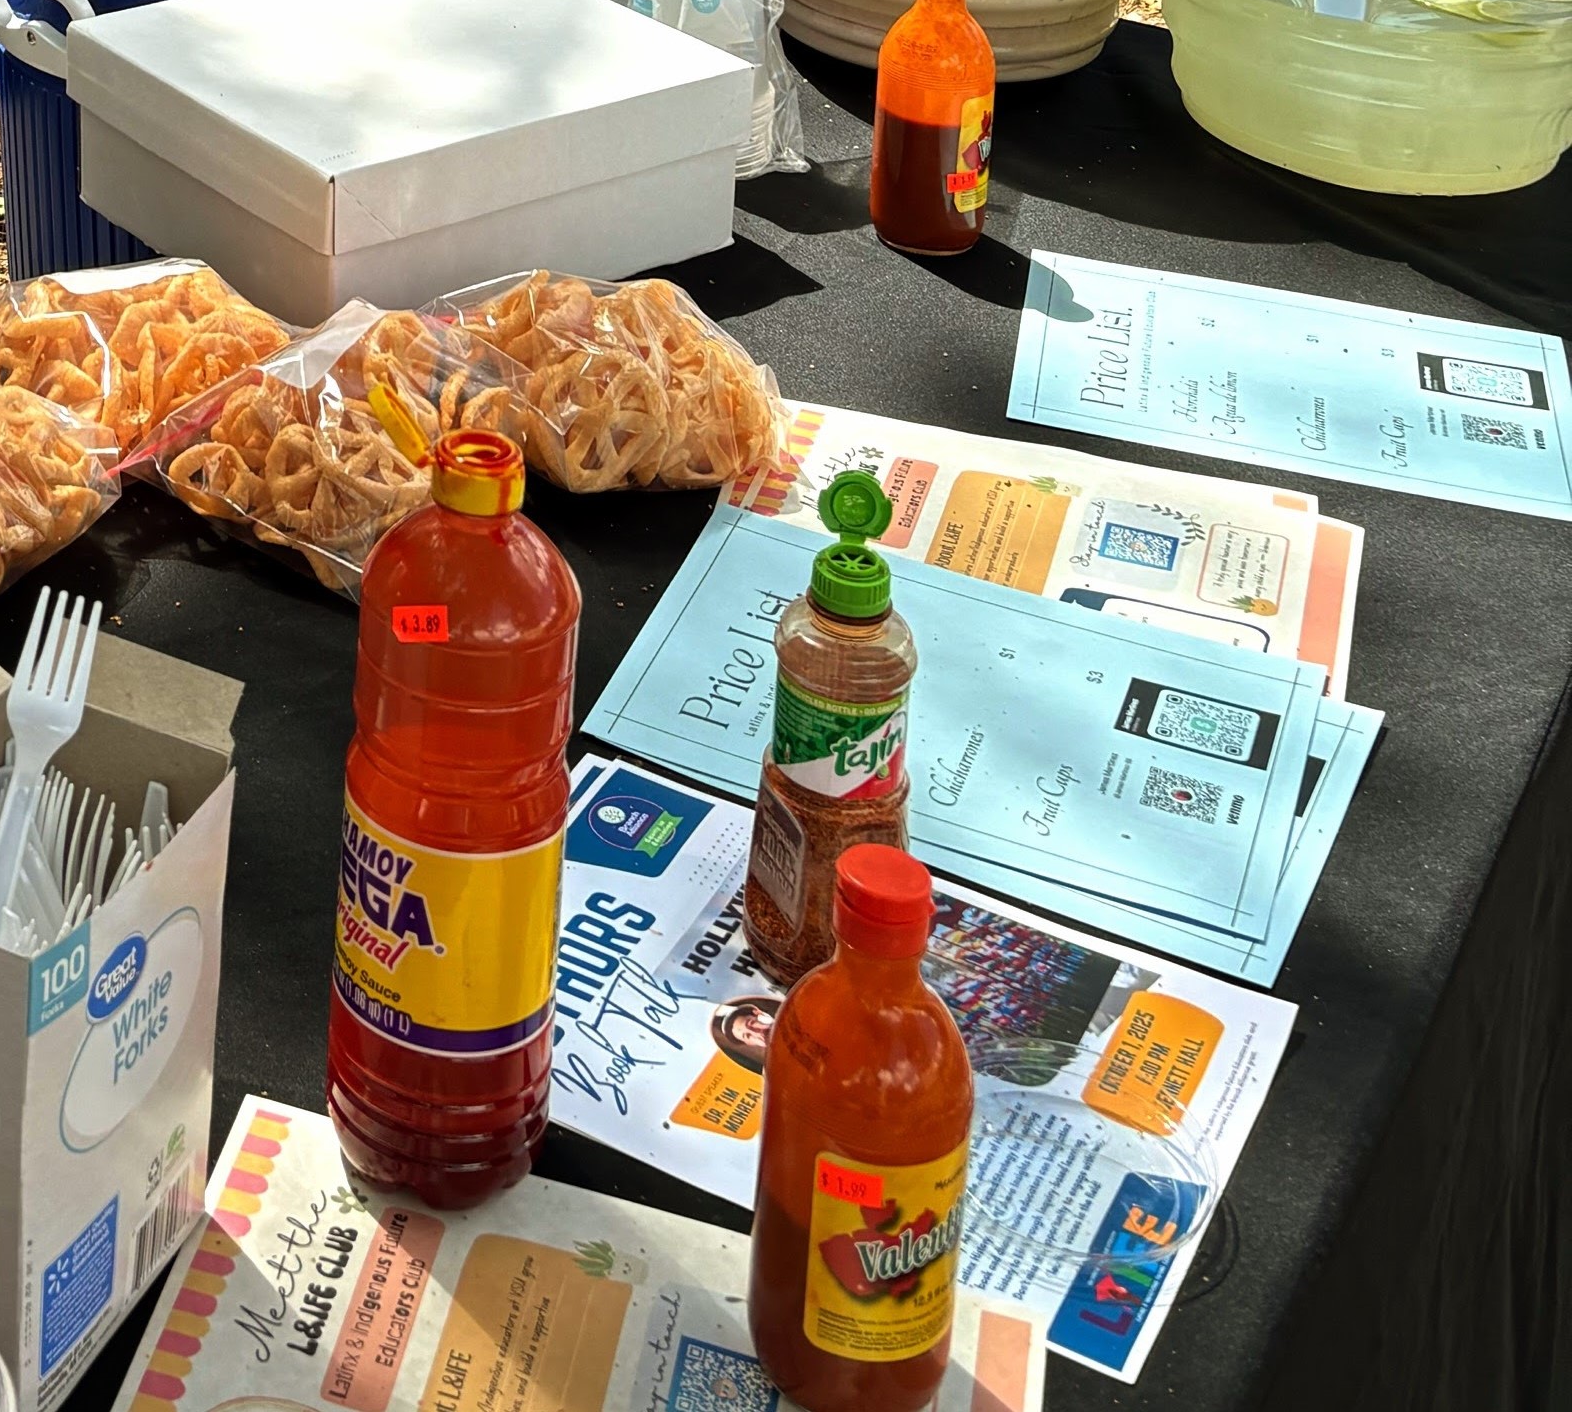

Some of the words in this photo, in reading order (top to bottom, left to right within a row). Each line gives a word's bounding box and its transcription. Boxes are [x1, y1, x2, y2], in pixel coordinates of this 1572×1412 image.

[1079, 349, 1128, 409] Price
[1296, 396, 1327, 451] Chicharrones
[412, 613, 441, 633] 3.89
[999, 647, 1016, 660] $1
[1086, 670, 1104, 684] $3
[678, 648, 765, 730] Price
[743, 711, 767, 738] Latinx
[928, 728, 985, 808] Chicharrones
[1036, 763, 1081, 800] Cups
[1022, 796, 1057, 837] Fruit
[1226, 794, 1245, 825] venmo
[341, 810, 414, 885] HAMOY
[339, 843, 435, 946] EGA
[40, 946, 85, 1002] 100
[94, 945, 138, 1001] Great
[104, 967, 139, 1005] Value
[359, 970, 403, 1003] Sauce
[112, 969, 173, 1049] White
[1127, 1008, 1156, 1042] 2025
[112, 1004, 169, 1085] Forks
[1147, 1041, 1171, 1064] PM
[1176, 1038, 1205, 1069] HALL
[702, 1108, 728, 1125] DR.
[715, 1086, 740, 1107] TIM
[837, 1177, 867, 1198] 1.99
[234, 1254, 303, 1363] Meet
[277, 1189, 327, 1253] the
[286, 1282, 338, 1357] L&IFE
[315, 1225, 359, 1280] CLUB
[329, 1354, 361, 1400] Latinx
[345, 1338, 365, 1351] &
[356, 1254, 394, 1338] Indigenous
[379, 1213, 409, 1254] Future
[375, 1290, 415, 1368] Educators
[401, 1257, 426, 1289] Club
[648, 1291, 682, 1352] touch
[443, 1348, 473, 1401] L&IFE
